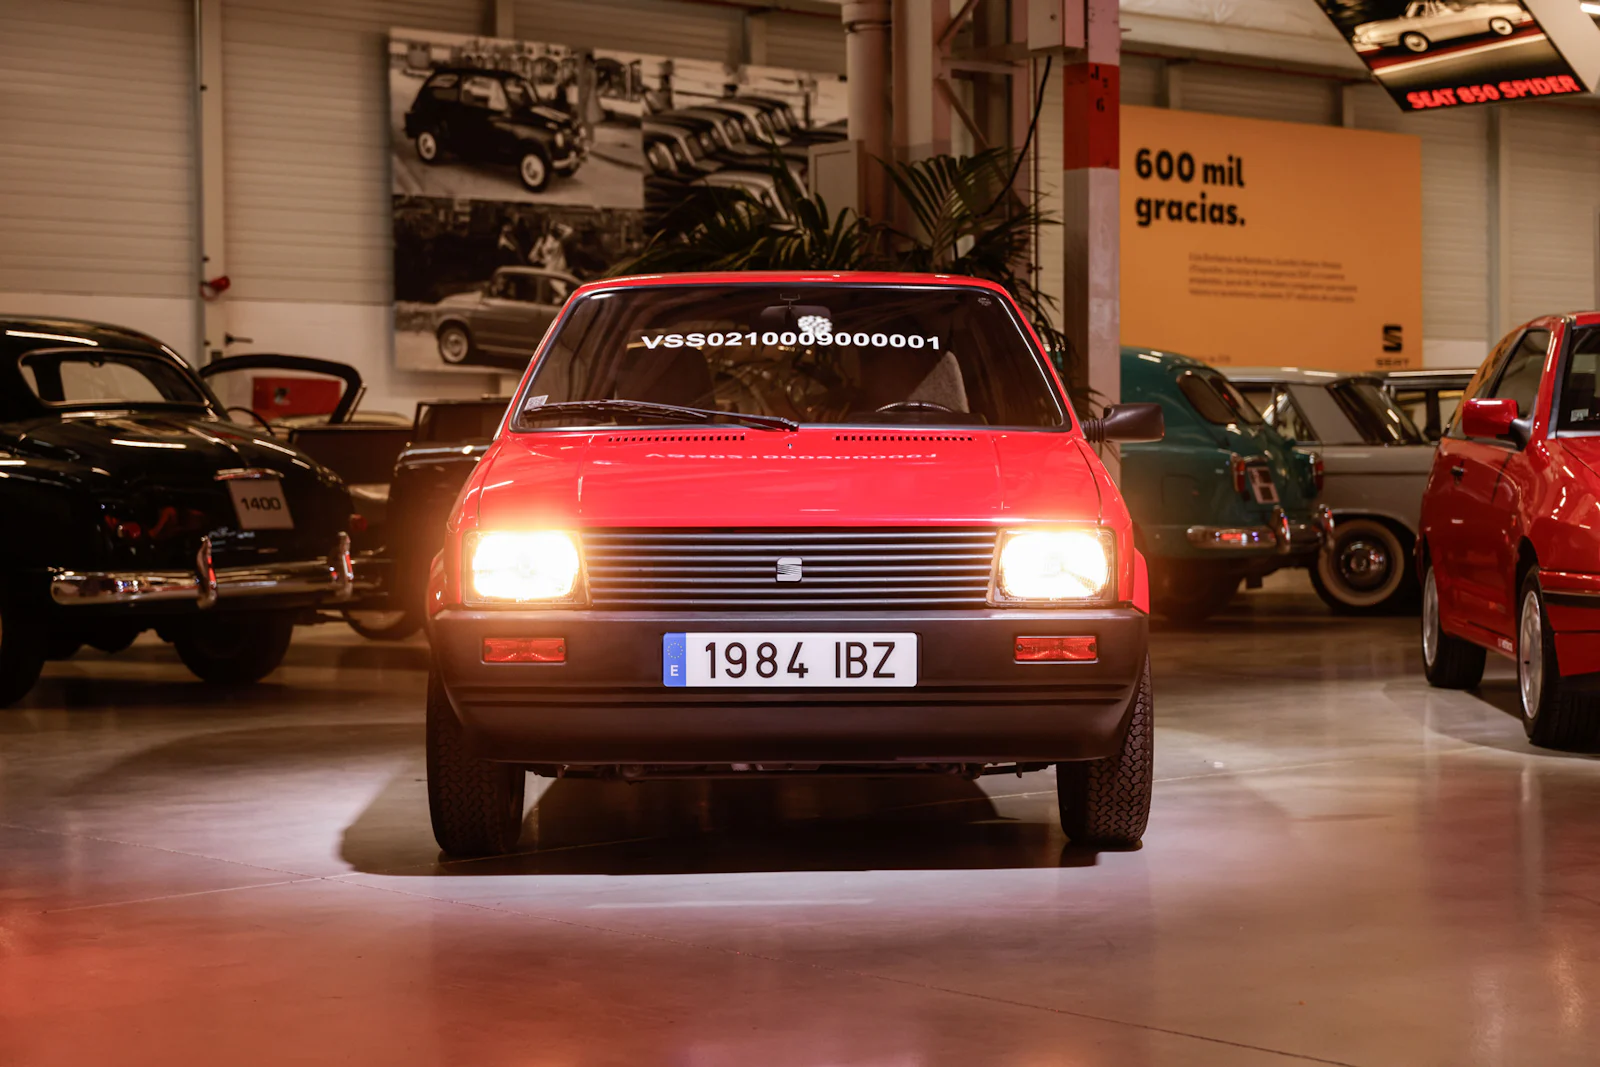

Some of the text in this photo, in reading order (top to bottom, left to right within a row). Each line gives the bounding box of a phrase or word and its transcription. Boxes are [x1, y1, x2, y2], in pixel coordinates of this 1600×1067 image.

[1406, 74, 1581, 109] SEAT 850 SPIDER
[1134, 147, 1246, 188] 600 mil
[1134, 191, 1246, 228] gracias.
[641, 331, 940, 350] VSS0210009000001
[240, 496, 282, 511] 1400
[669, 641, 896, 679] E 1984 IBZ
